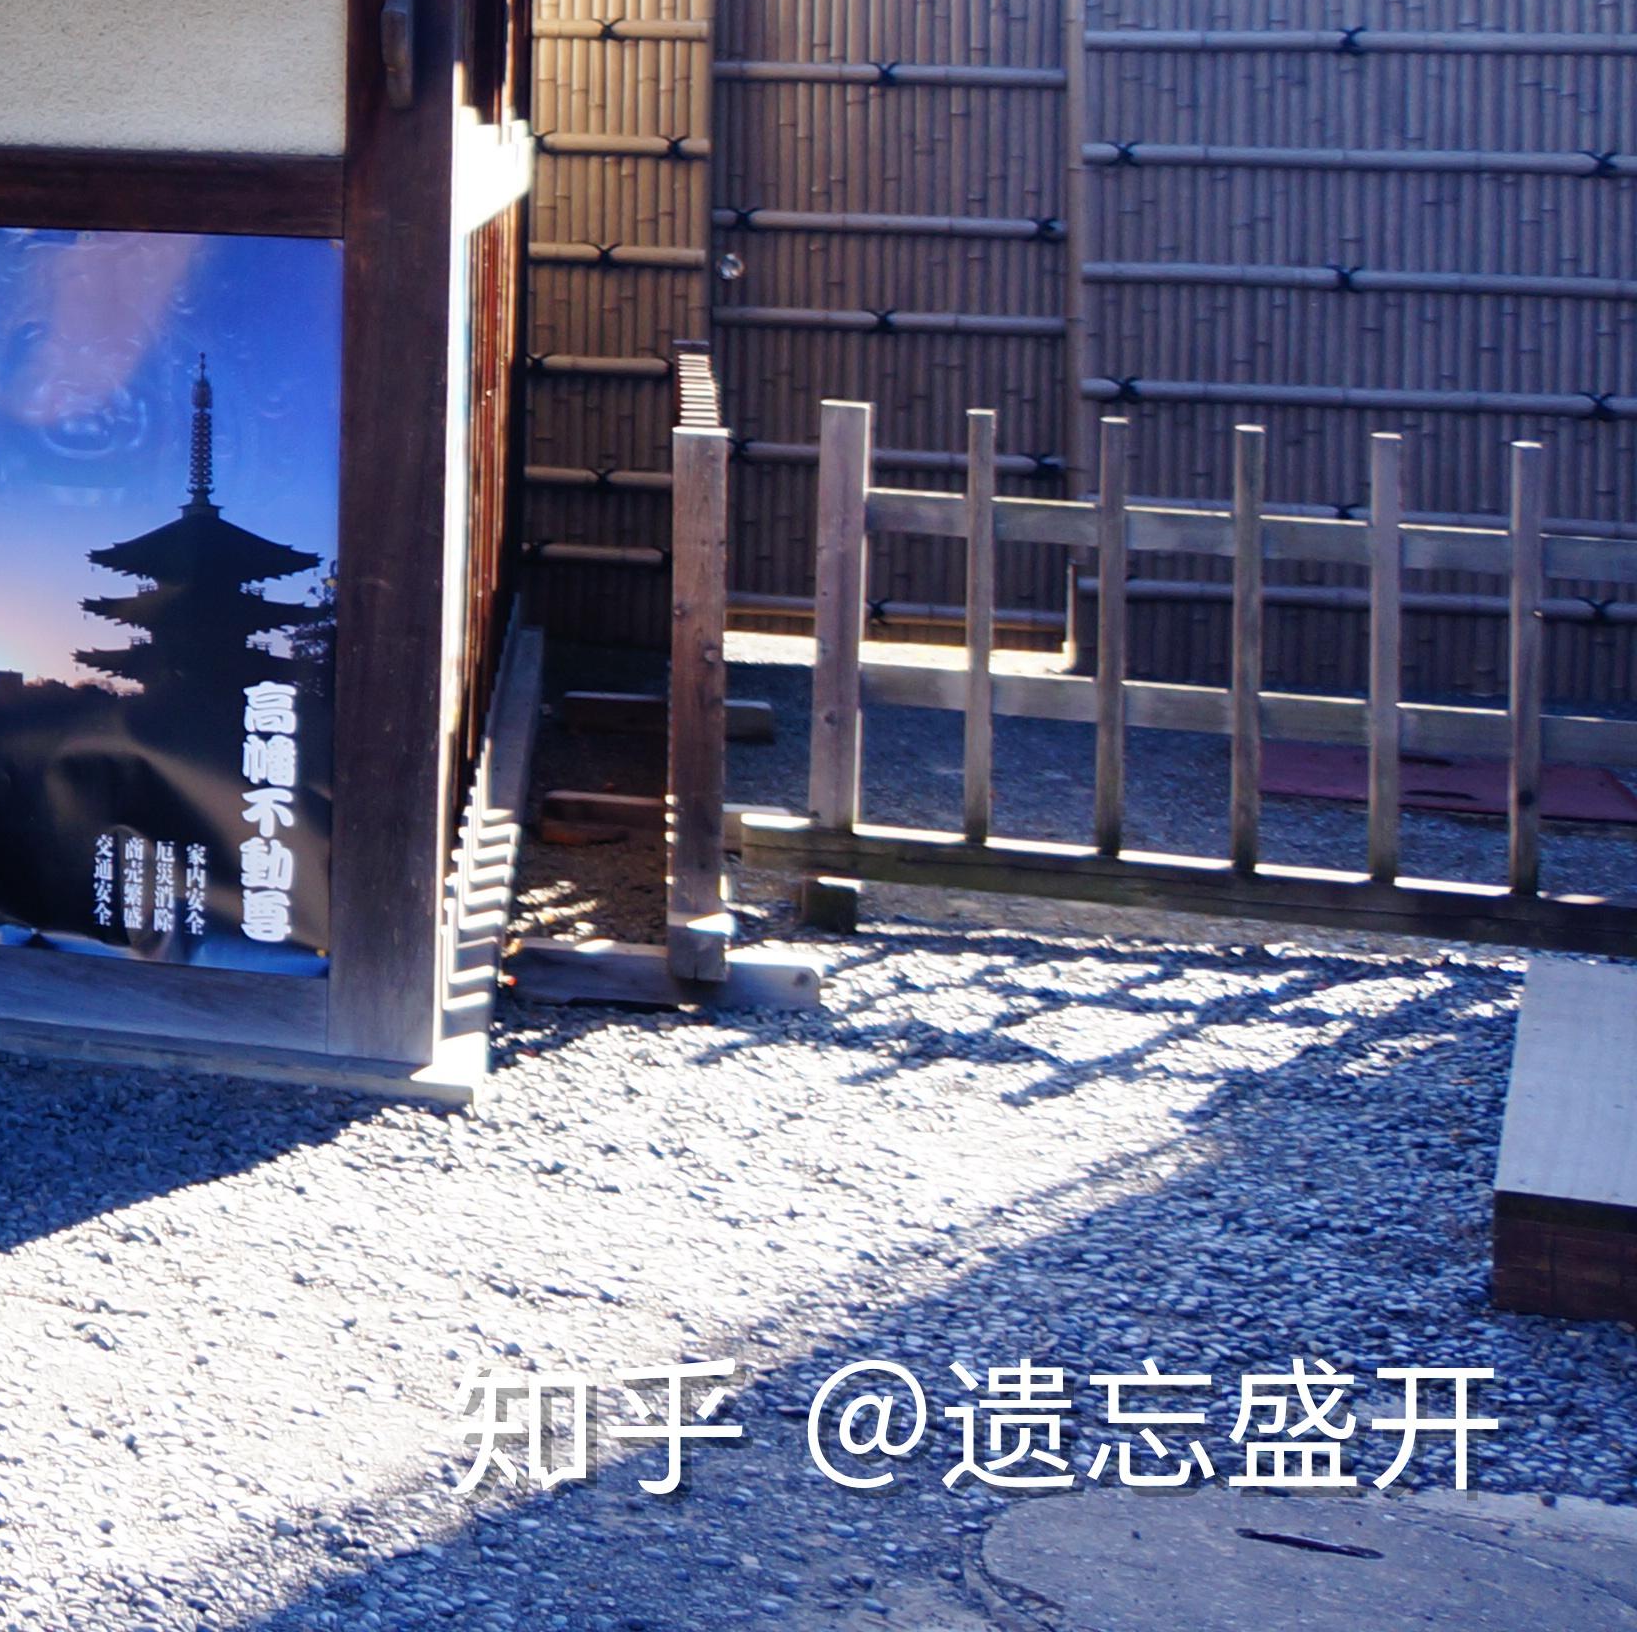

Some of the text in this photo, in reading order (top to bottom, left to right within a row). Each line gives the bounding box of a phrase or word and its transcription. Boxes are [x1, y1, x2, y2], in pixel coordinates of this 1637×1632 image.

[239, 680, 297, 943] 高幡不動尊
[92, 833, 115, 927] 交通安全
[123, 836, 144, 930] 商売繁盛
[153, 839, 176, 933] 厄災消除
[184, 842, 207, 936] 家内安全
